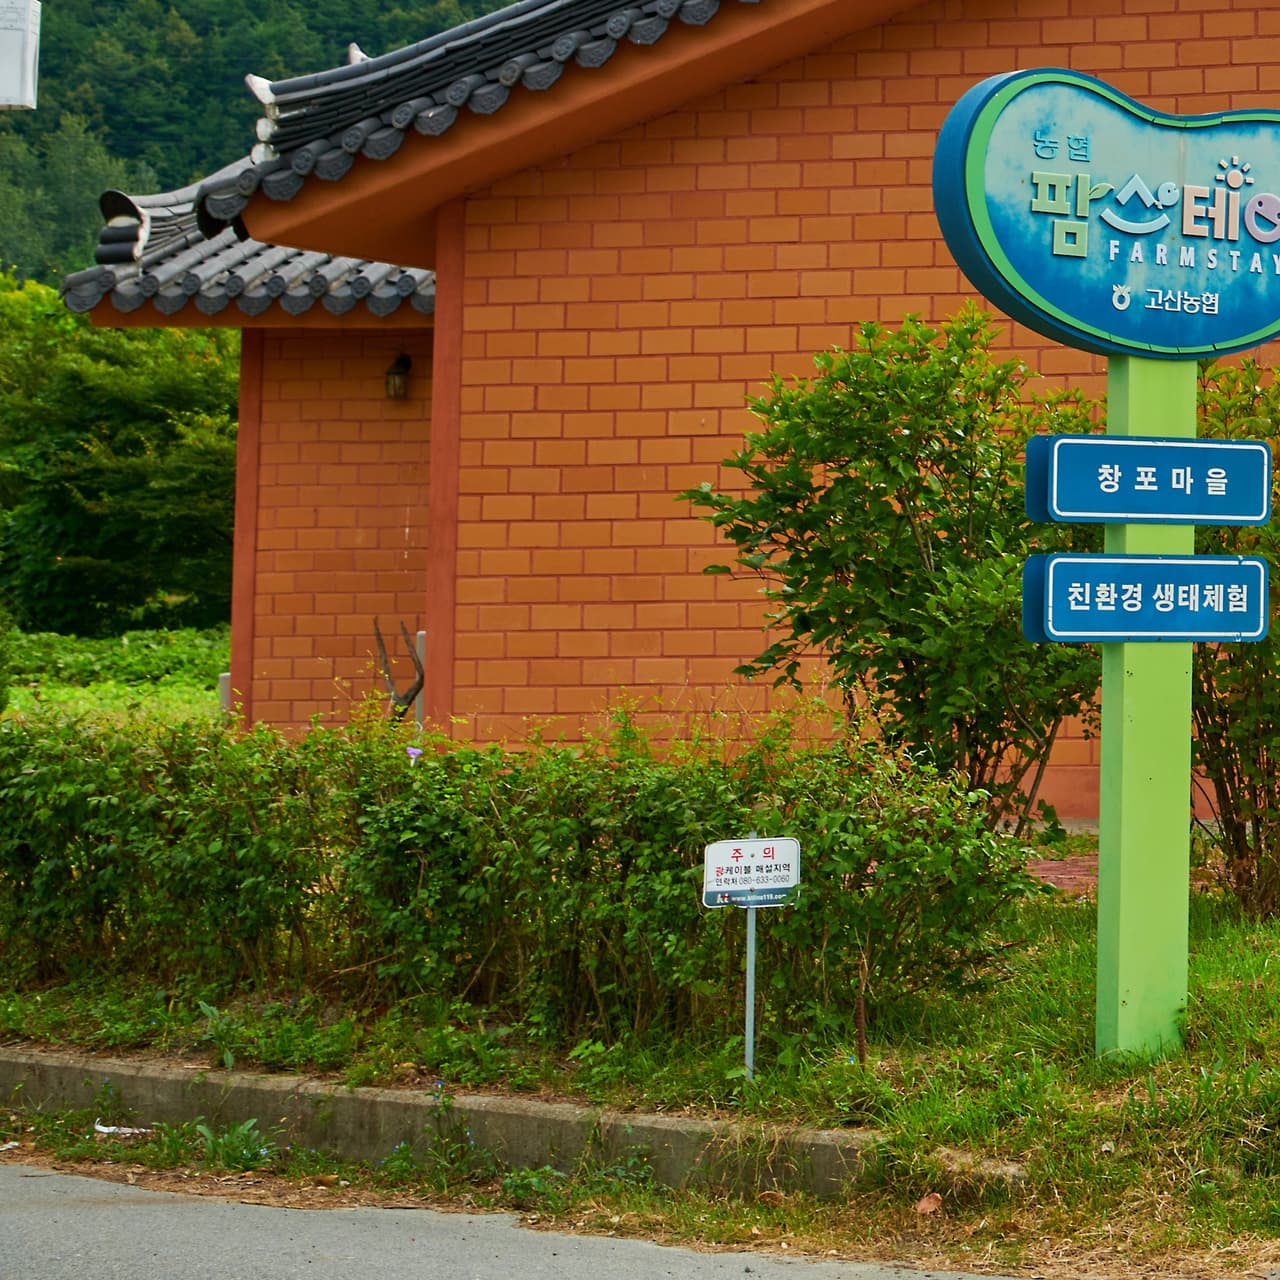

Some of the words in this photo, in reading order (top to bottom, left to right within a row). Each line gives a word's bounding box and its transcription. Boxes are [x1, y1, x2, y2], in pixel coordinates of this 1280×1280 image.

[1144, 289, 1220, 315] 고산농협
[1067, 581, 1143, 612] 친환경
[1152, 582, 1249, 613] 생태체험
